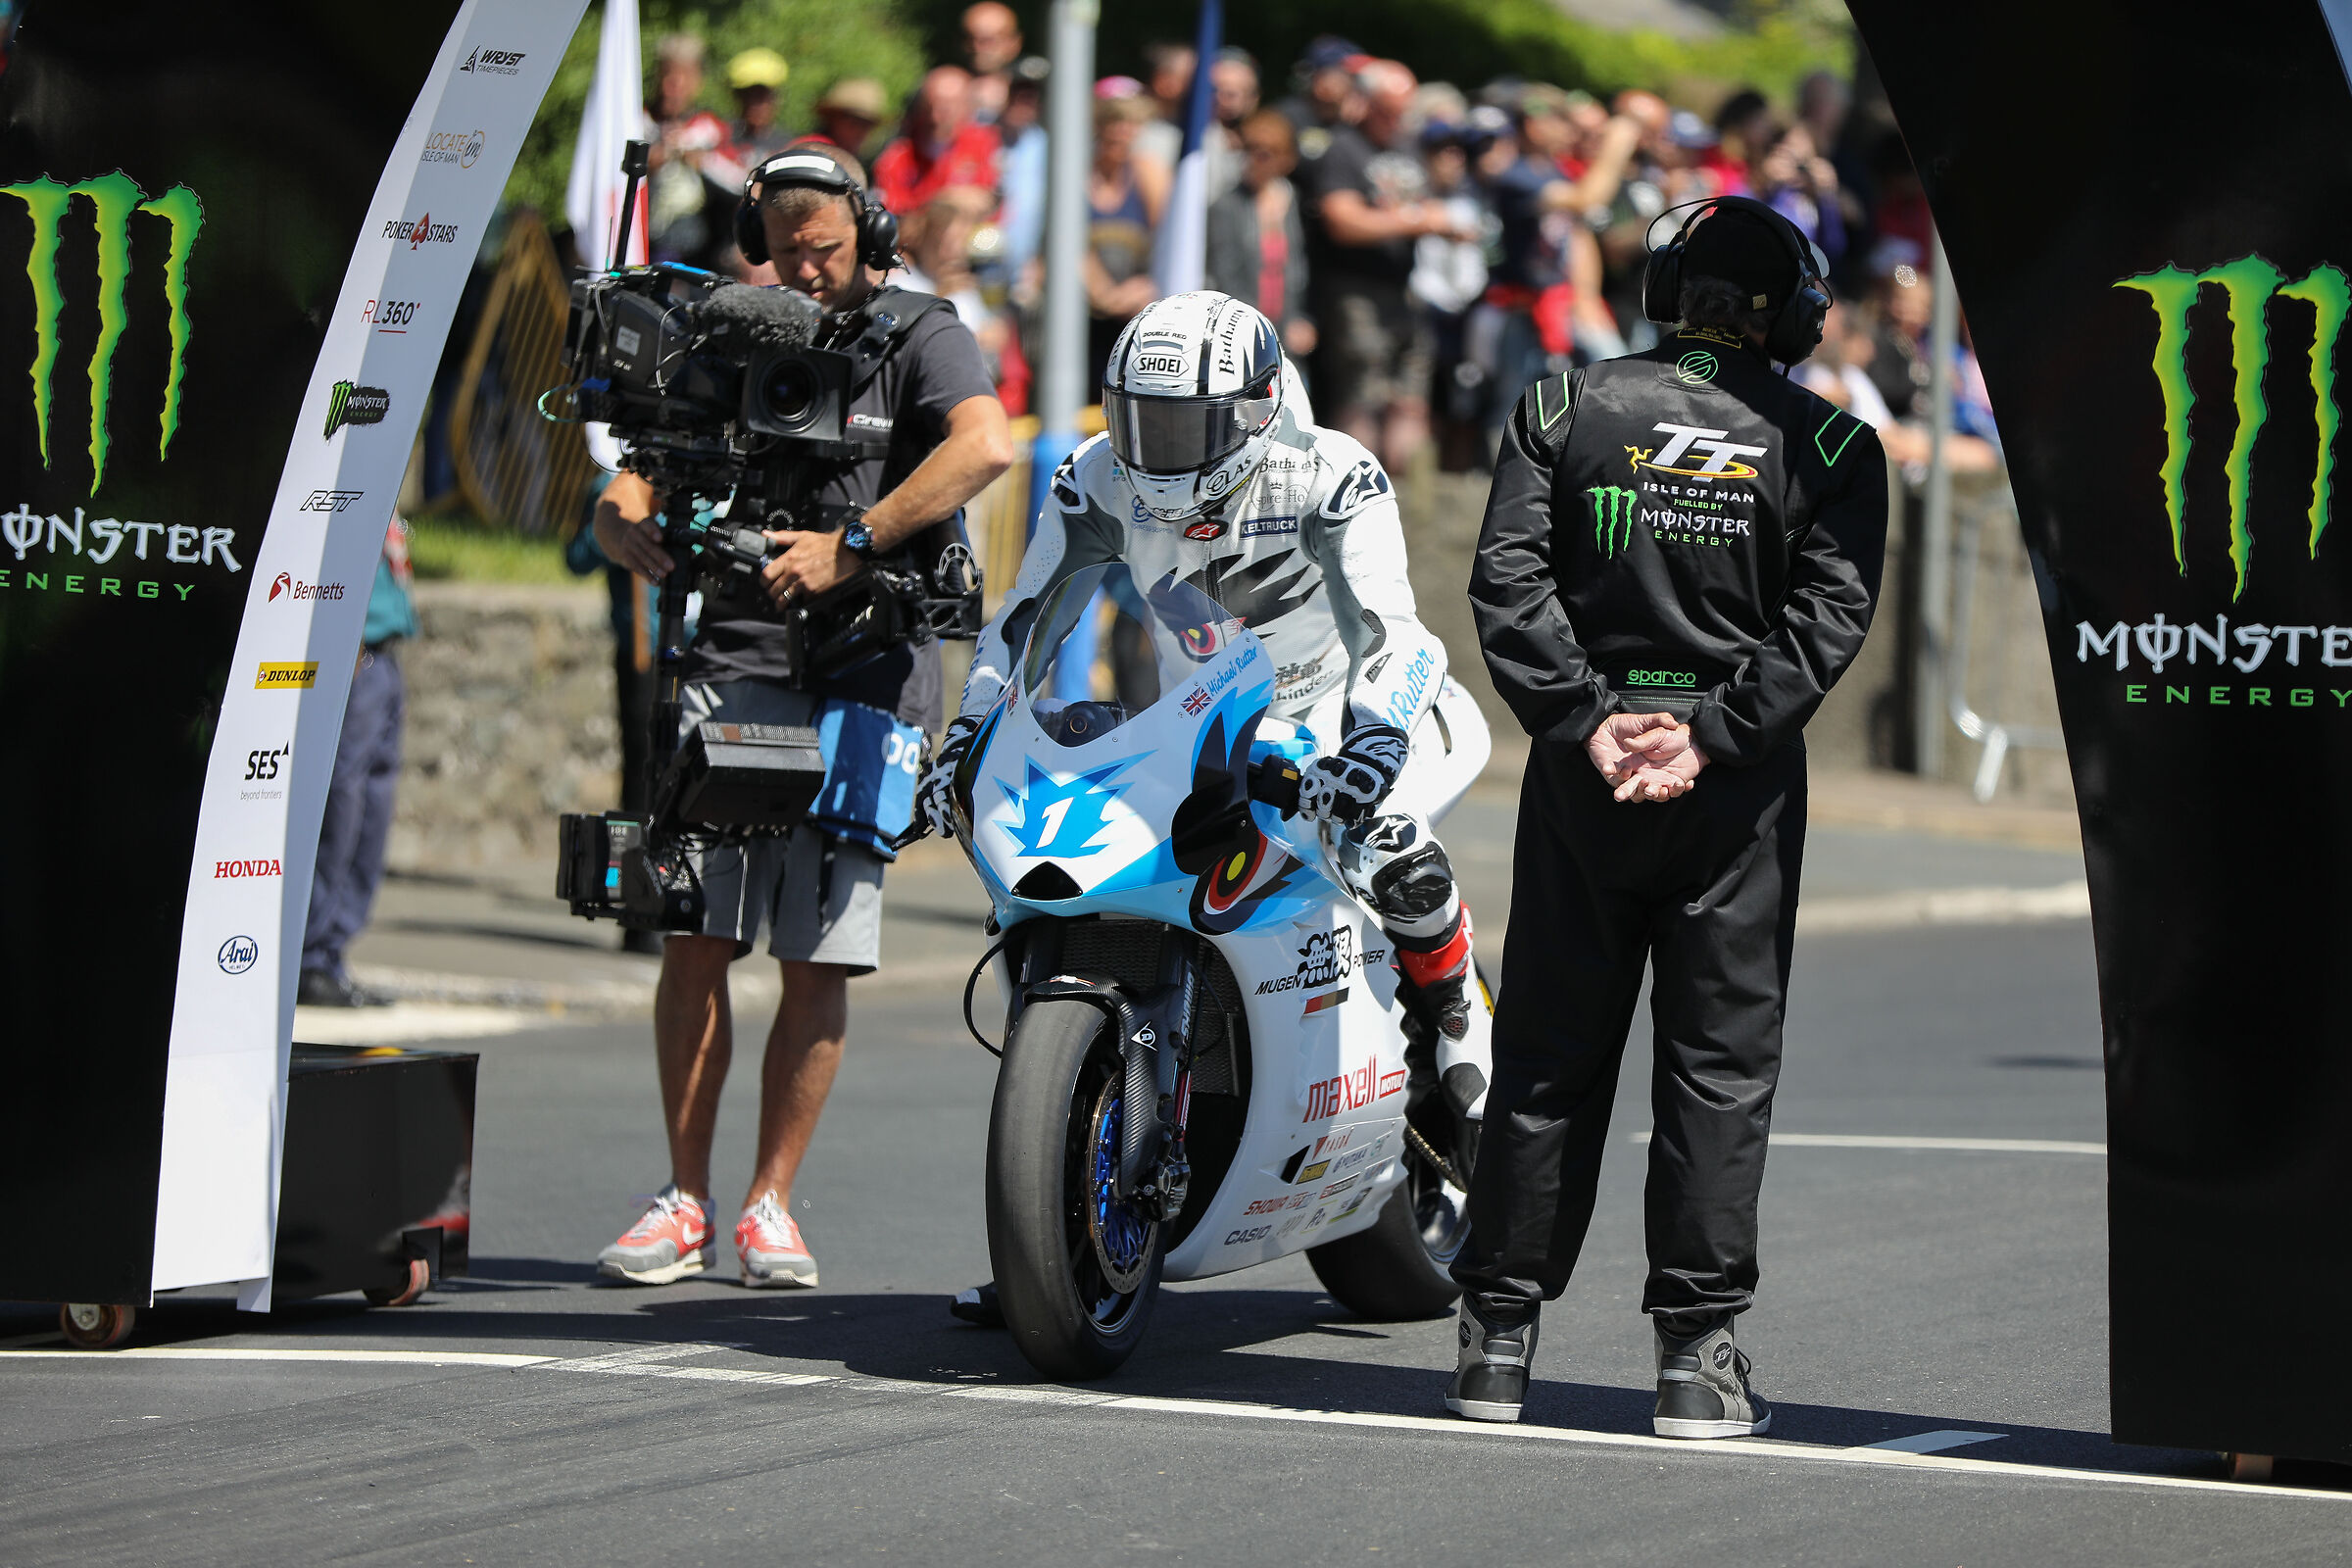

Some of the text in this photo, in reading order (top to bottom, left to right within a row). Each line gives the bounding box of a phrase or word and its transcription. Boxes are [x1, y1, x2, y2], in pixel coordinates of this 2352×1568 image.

[480, 50, 526, 66] WRYST
[475, 65, 520, 75] TIMEPIECES
[425, 132, 468, 152] LOCATE
[444, 153, 461, 164] MAN
[382, 220, 458, 243] POKER STARS
[1139, 357, 1182, 373] SHOEI
[347, 395, 387, 410] MONSTER
[1651, 421, 1768, 483] TT
[299, 490, 366, 512] RST
[1642, 481, 1755, 504] ISLE OF MAN
[1673, 498, 1724, 512] FUELLED BY
[1241, 518, 1298, 535] KELTRUCK
[1640, 507, 1751, 537] MONSTER
[1654, 530, 1734, 548] ENERGY
[293, 580, 346, 601] Bennetts
[267, 670, 316, 683] DUNLOP
[1206, 645, 1259, 698] Michael Rutter
[1627, 669, 1697, 686] sparco
[2127, 684, 2352, 708] ENERGY
[244, 750, 281, 781] SES
[240, 788, 282, 802] beyond frontiers
[1036, 796, 1075, 850] 1
[214, 859, 282, 879] HONDA
[220, 940, 254, 964] Arai
[1254, 974, 1302, 996] MUGEN
[1353, 949, 1386, 968] POWER
[1302, 1054, 1377, 1123] maxell
[1381, 1074, 1403, 1096] MOTUL
[1224, 1224, 1273, 1246] CASIO
